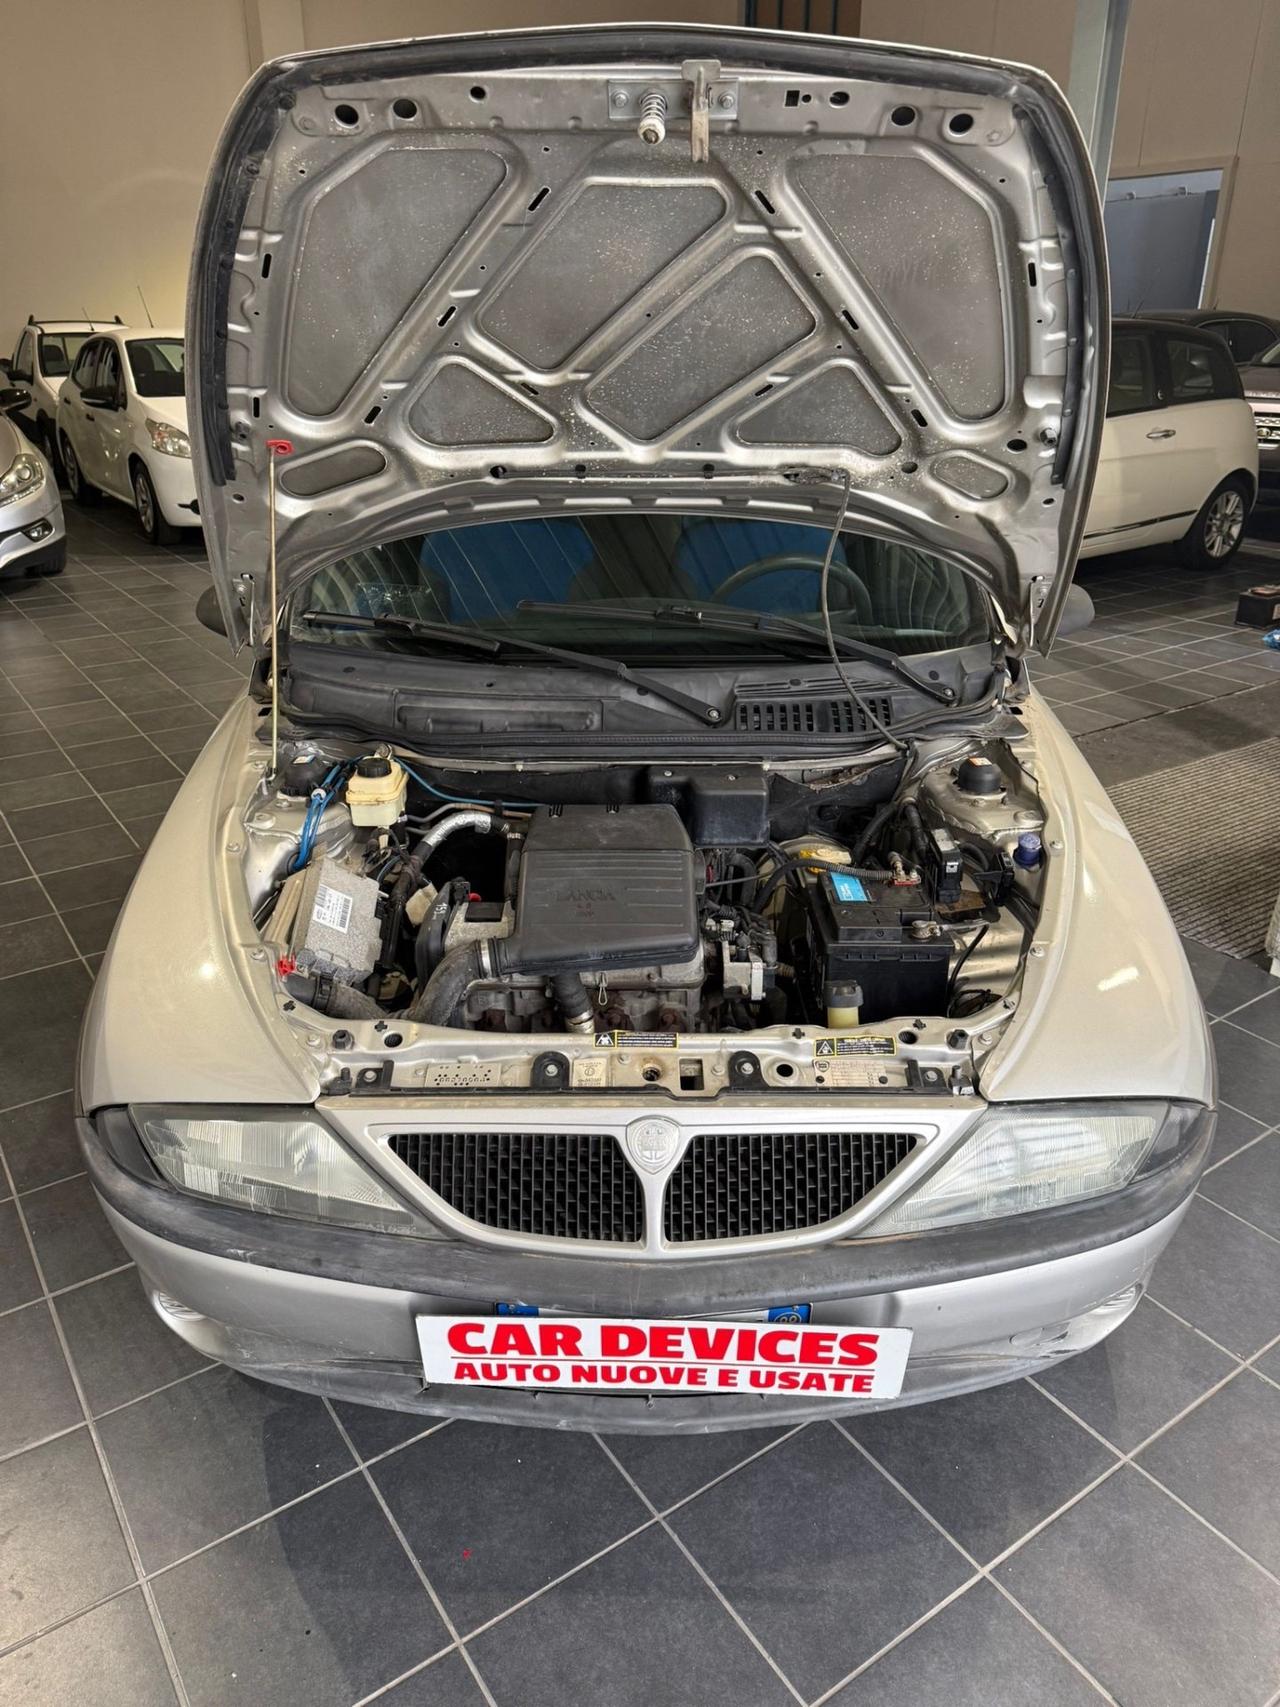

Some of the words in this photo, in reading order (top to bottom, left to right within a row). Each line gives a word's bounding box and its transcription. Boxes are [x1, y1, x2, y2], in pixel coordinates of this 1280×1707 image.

[447, 1322, 582, 1357] CAR
[600, 1324, 879, 1367] DEVICES
[454, 1362, 561, 1383] AUTO
[571, 1364, 707, 1386] NUOVE
[717, 1368, 738, 1387] E
[749, 1370, 874, 1393] USATE
